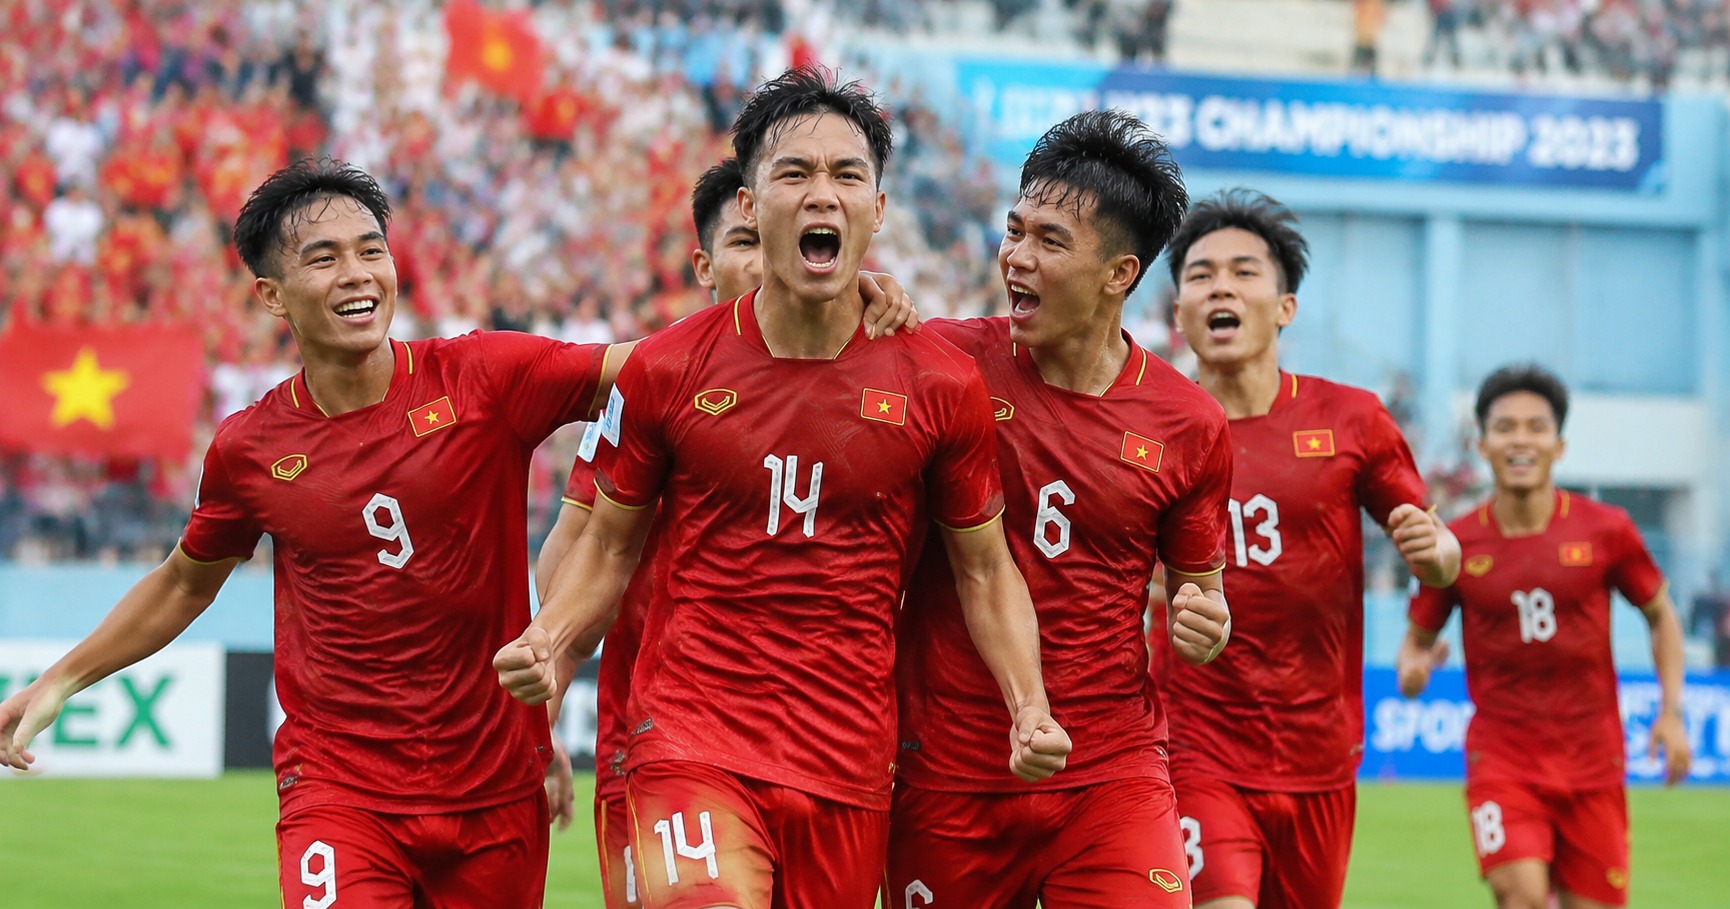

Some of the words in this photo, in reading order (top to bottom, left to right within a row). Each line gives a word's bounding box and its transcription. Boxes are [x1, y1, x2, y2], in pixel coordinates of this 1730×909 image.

[1197, 95, 1527, 166] CHAMPIONSHIP
[1528, 114, 1639, 171] 2023
[361, 492, 415, 569] 9
[763, 453, 824, 538] 14
[1033, 479, 1076, 559] 6
[1228, 493, 1283, 567] 13
[1511, 587, 1557, 643] 18
[0, 673, 174, 748] EX
[653, 811, 719, 886] 14
[1472, 800, 1505, 856] 18
[300, 839, 337, 909] 9
